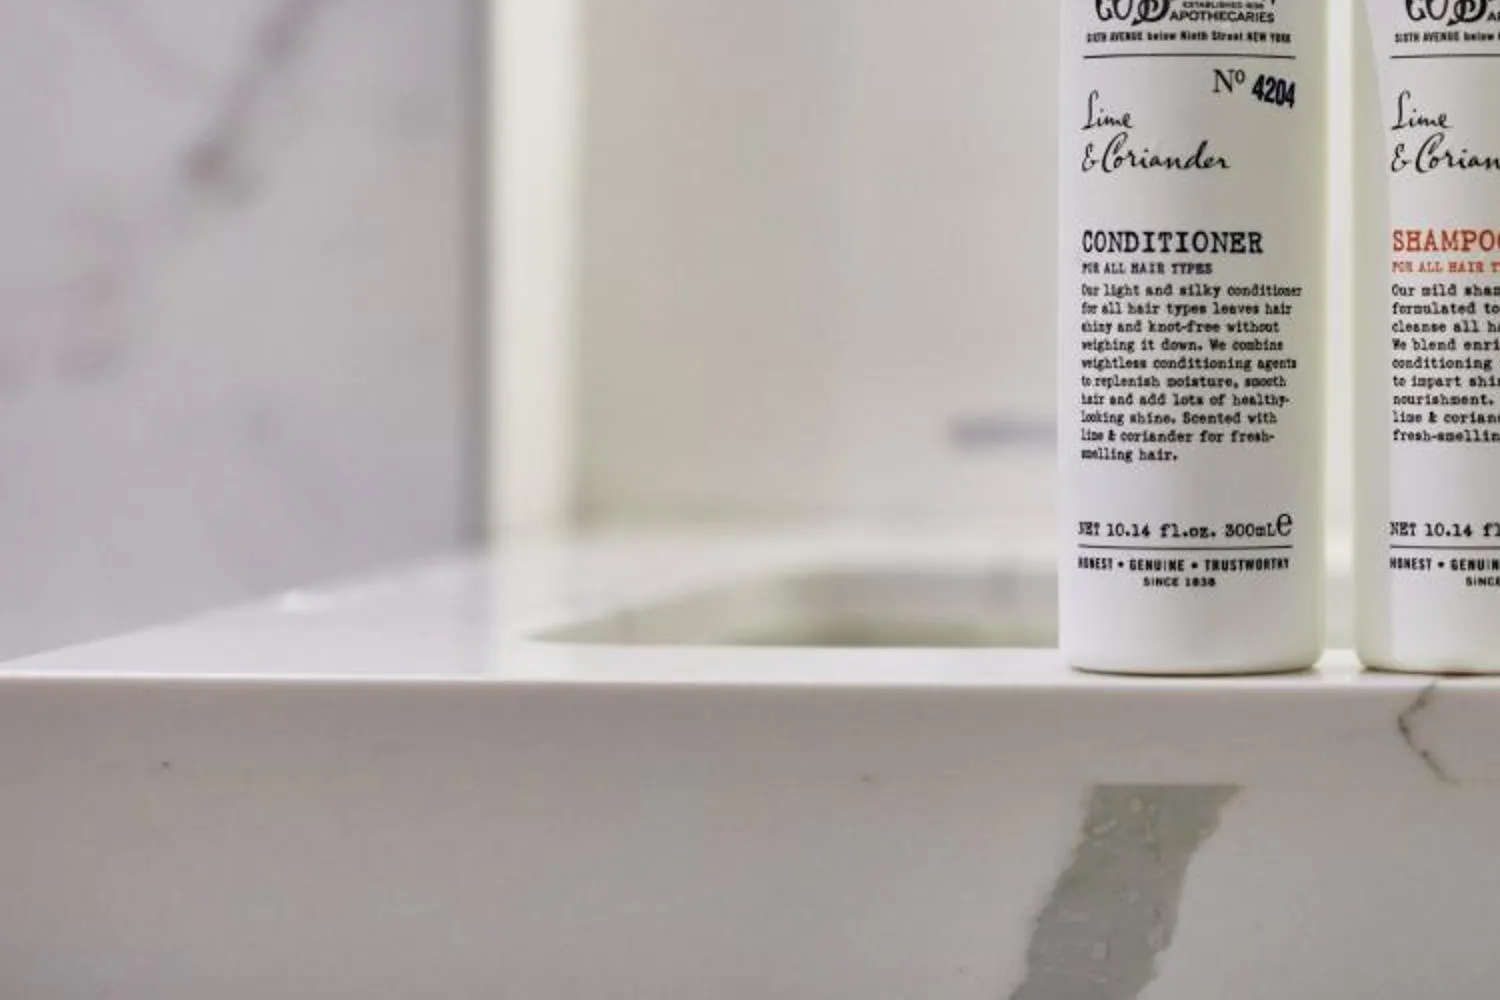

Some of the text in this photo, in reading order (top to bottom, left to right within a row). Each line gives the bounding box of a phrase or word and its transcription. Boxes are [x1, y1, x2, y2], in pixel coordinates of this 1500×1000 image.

[1169, 11, 1275, 22] APOTHECARIES
[1211, 31, 1243, 41] Street
[1247, 32, 1266, 42] NEW
[1252, 74, 1295, 108] 4204
[1082, 90, 1133, 130] Lime
[1392, 90, 1451, 130] Lime
[1102, 132, 1231, 172] Coriander
[1082, 231, 1263, 253] CONDITIONER
[1103, 263, 1212, 274] ALL HAIR TYPES
[1418, 262, 1442, 272] ALL
[1448, 262, 1484, 272] HAIR
[1104, 285, 1303, 298] light and silky conditioner
[1393, 285, 1415, 296] Our
[1422, 285, 1456, 296] mild
[1082, 303, 1292, 316] for all hair types leaves hair
[1393, 303, 1475, 314] formulated
[1485, 303, 1500, 314] to
[1117, 321, 1141, 333] and
[1148, 321, 1220, 333] knot-free
[1227, 321, 1279, 333] without
[1393, 321, 1446, 333] cleanse
[1454, 321, 1478, 333] all
[1082, 339, 1283, 352] weighing it down. combine
[1412, 340, 1455, 350] blend
[1082, 358, 1146, 371] weightless
[1153, 358, 1251, 371] conditioning
[1393, 358, 1492, 370] conditioning
[1095, 376, 1239, 389] replenish moisture,
[1393, 376, 1406, 387] to
[1412, 376, 1460, 389] impart
[1110, 394, 1133, 406] and
[1140, 394, 1165, 406] add
[1173, 394, 1202, 406] lots
[1210, 394, 1226, 406] of
[1393, 394, 1494, 405] nourishment.
[1130, 412, 1276, 424] shine. Scented with
[1120, 430, 1193, 442] coriander
[1200, 430, 1224, 442] for
[1140, 449, 1178, 461] hair.
[1107, 523, 1150, 537] 10.14
[1390, 522, 1417, 536] NET
[1425, 523, 1471, 537] 10.14
[1129, 559, 1184, 571] GENUINE
[1205, 557, 1289, 571] TRUSTWORTHY
[1143, 578, 1178, 586] SINCE
